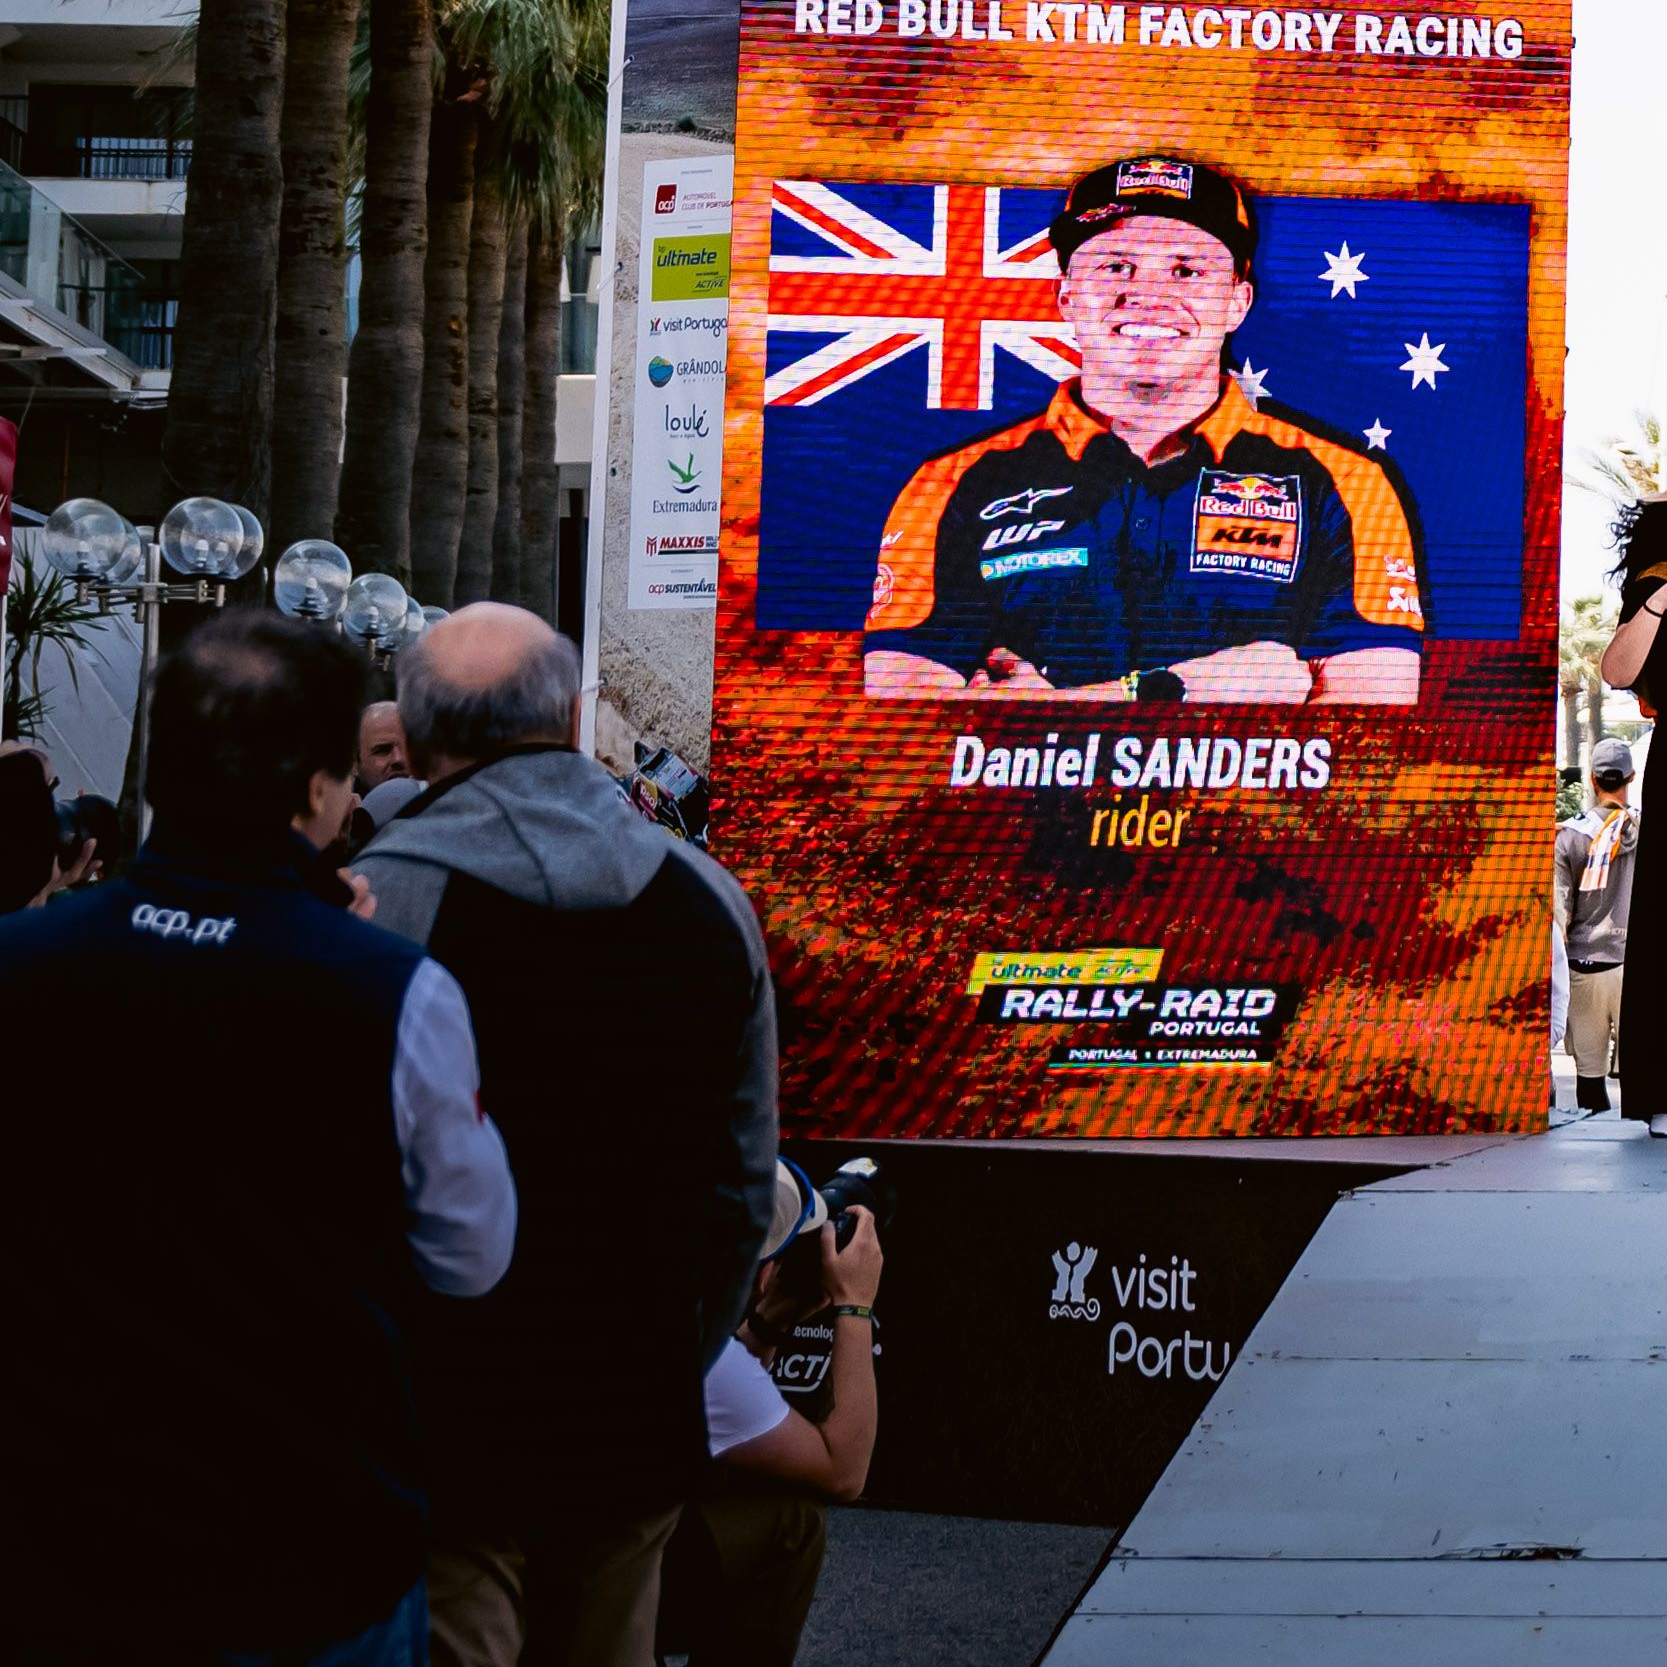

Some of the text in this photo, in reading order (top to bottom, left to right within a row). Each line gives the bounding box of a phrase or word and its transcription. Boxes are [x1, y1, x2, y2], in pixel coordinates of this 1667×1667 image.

[1024, 2, 1126, 46] KTM
[1139, 5, 1342, 53] FACTORY
[1353, 13, 1524, 59] RACING
[705, 200, 734, 210] PORTUG
[656, 247, 717, 267] ultimate
[663, 316, 729, 338] visit Portuga
[676, 357, 728, 376] GRÂNDOL
[665, 403, 710, 438] loulé
[652, 498, 718, 514] Extremadura
[1200, 495, 1297, 522] Red Bull
[659, 535, 705, 549] MAXXIS
[1210, 525, 1284, 549] KTM
[1195, 553, 1291, 577] FACTORY RACING
[665, 577, 717, 594] SUSTENTÁVEL
[950, 733, 1331, 790] Daniel SANDERS
[1089, 796, 1191, 849] rider
[131, 902, 237, 944] acp.pt
[991, 962, 1082, 979] ultimate
[1000, 988, 1277, 1019] RALLY-RAID
[1149, 1020, 1261, 1036] PORTUGAL
[1068, 1048, 1258, 1061] PORTUGAL EXTREMADURA
[1111, 1253, 1198, 1313] visit
[793, 1323, 832, 1341] ecnolog
[1108, 1321, 1231, 1383] Portu
